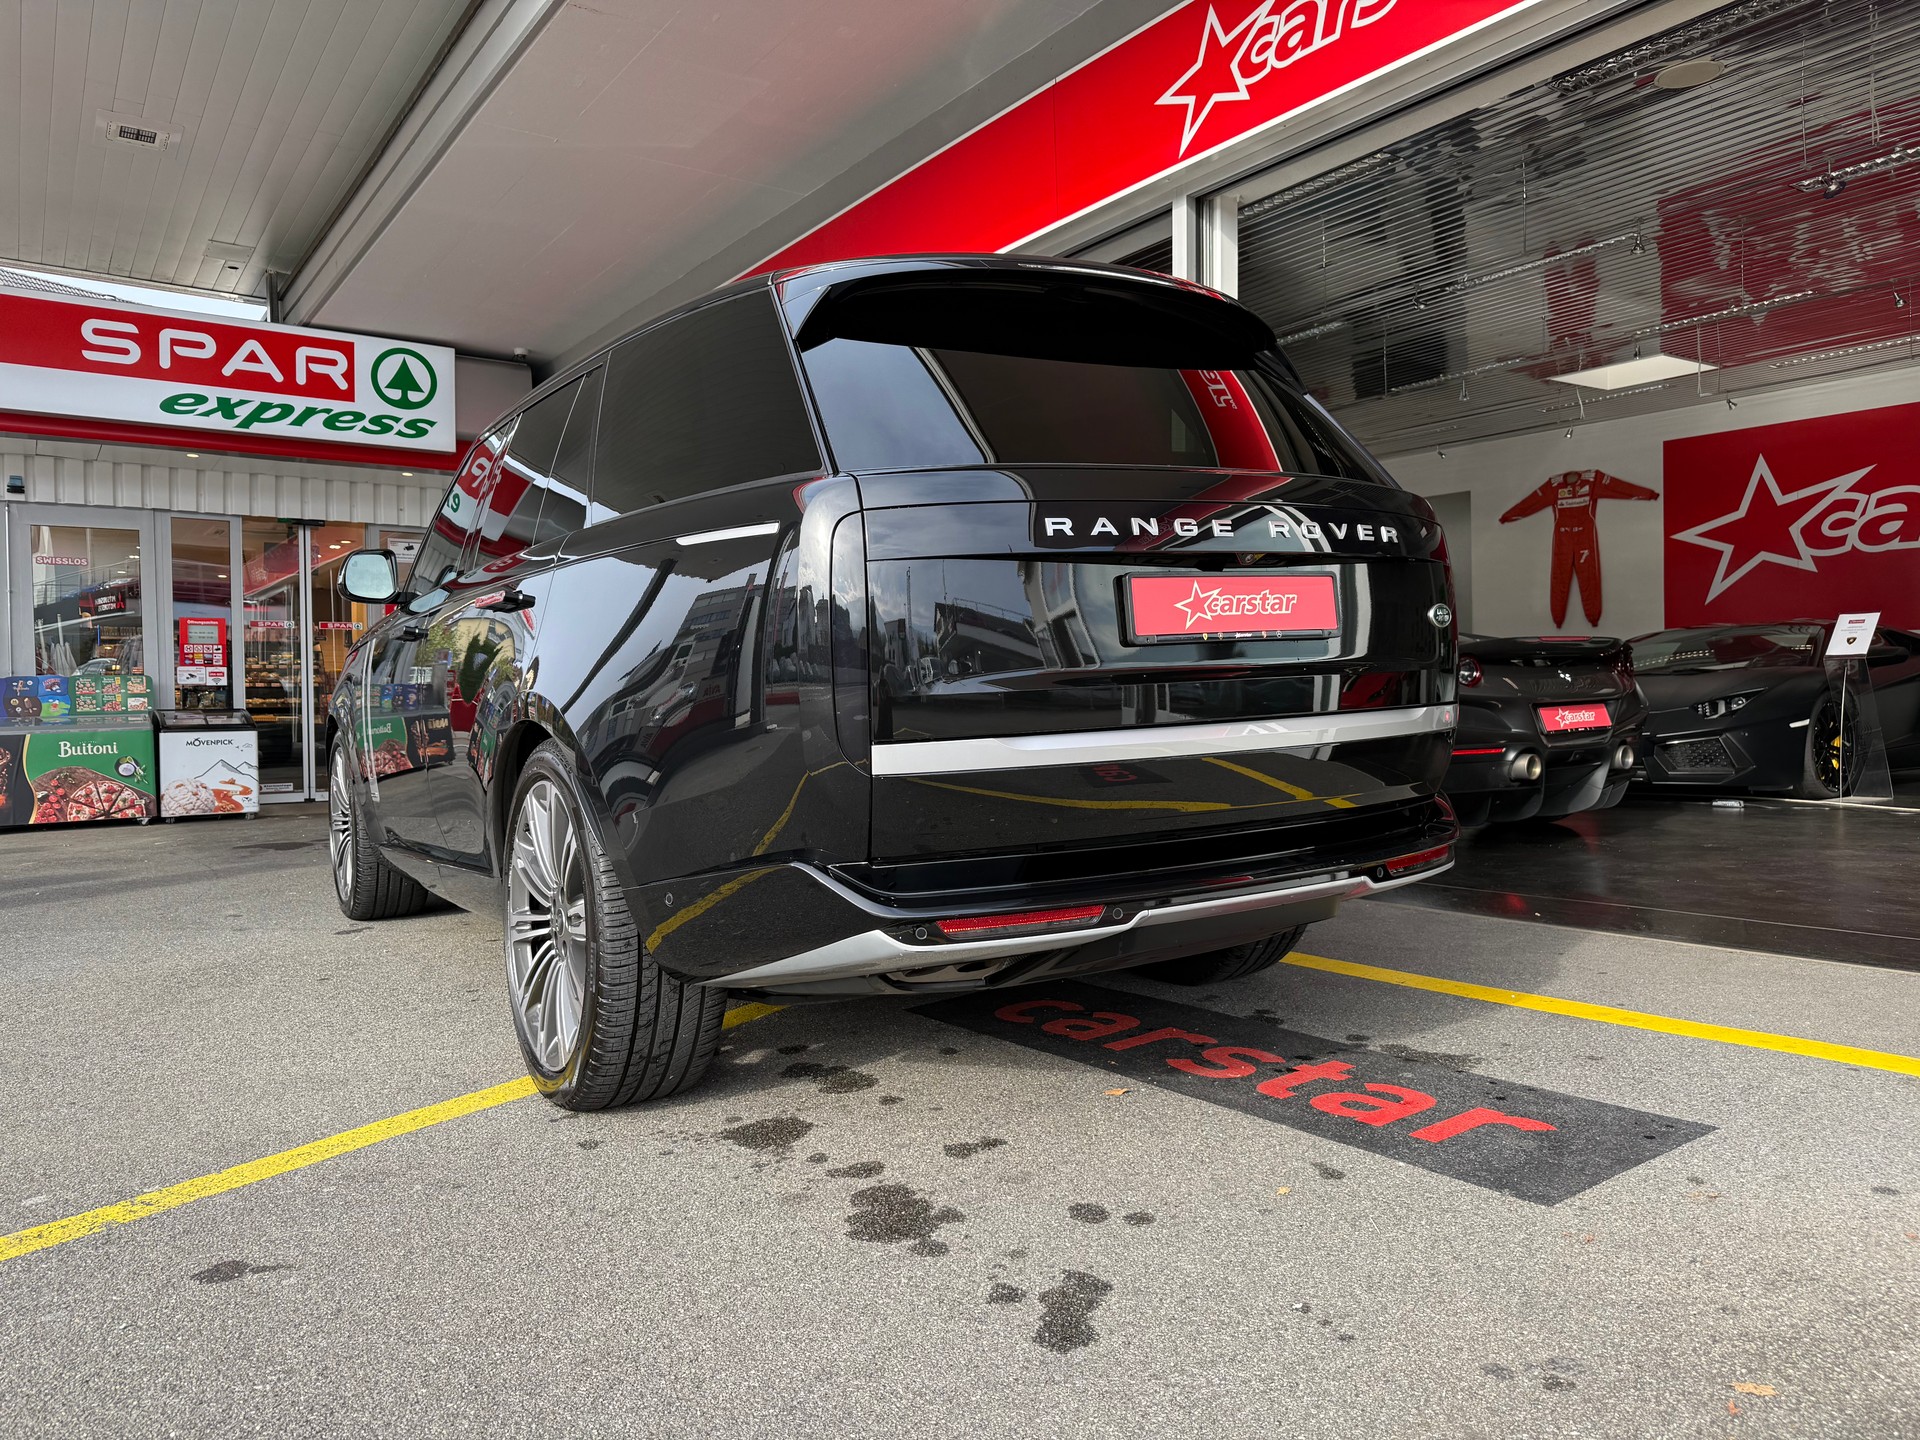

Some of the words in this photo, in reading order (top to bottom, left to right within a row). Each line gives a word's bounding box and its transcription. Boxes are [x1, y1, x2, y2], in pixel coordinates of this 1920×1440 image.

[81, 318, 349, 391] SPAR
[159, 392, 438, 439] express
[1044, 517, 1235, 538] RANGE
[1268, 520, 1399, 543] ROVER
[35, 556, 88, 566] SWISSLOS
[1579, 549, 1590, 563] 7
[1203, 589, 1298, 616] carstar
[58, 741, 118, 758] Buitoni
[994, 997, 1558, 1144] carstar
